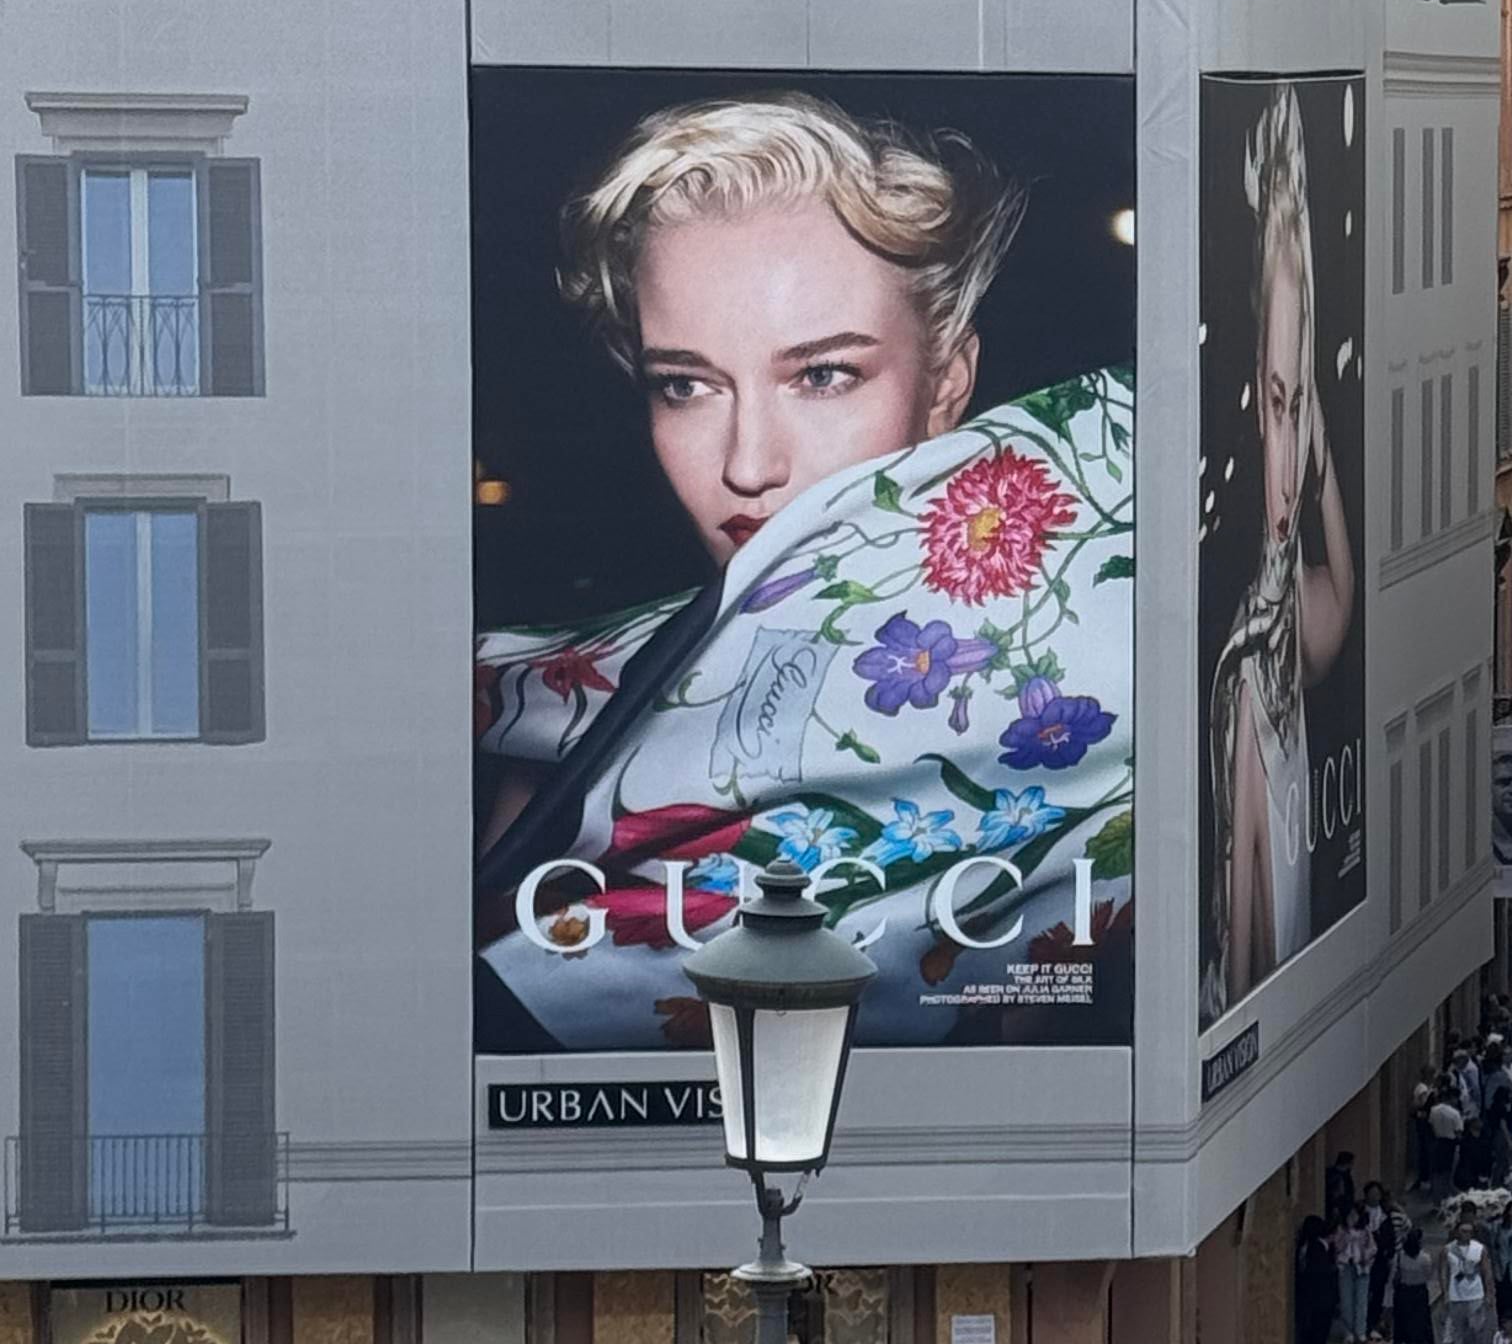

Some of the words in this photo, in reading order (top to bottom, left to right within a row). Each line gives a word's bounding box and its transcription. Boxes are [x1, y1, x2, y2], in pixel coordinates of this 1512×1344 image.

[1285, 738, 1361, 866] GUCCI
[1007, 963, 1039, 974] KEEP
[1041, 963, 1052, 974] IT
[1054, 963, 1093, 974] GUCCI
[500, 1088, 648, 1122] URBAN
[106, 1289, 188, 1313] DIOR
